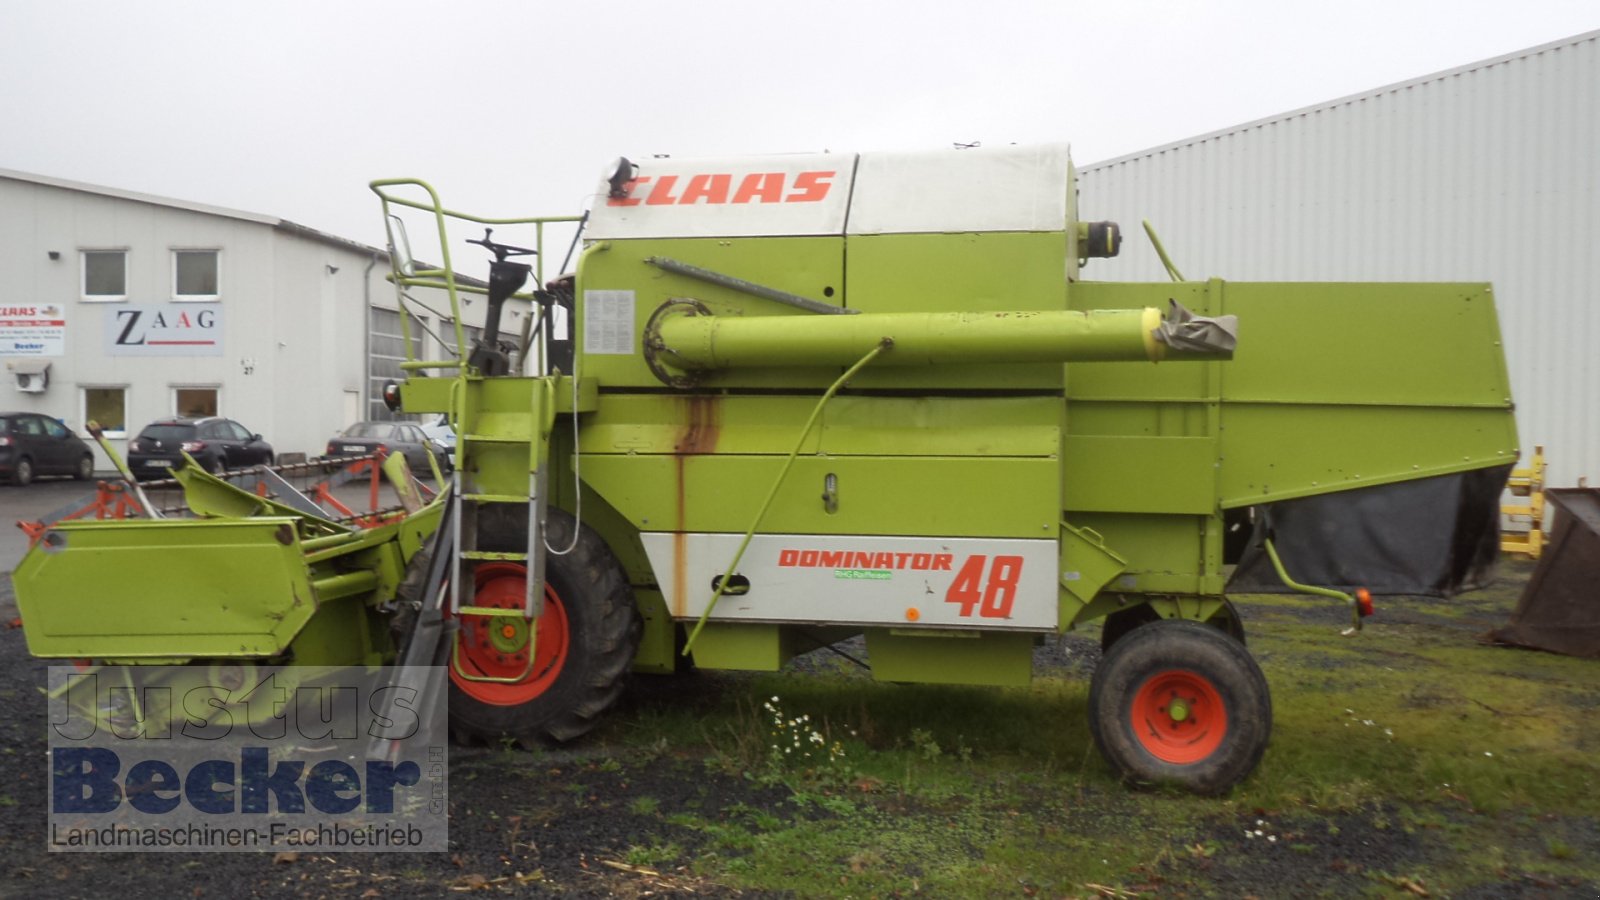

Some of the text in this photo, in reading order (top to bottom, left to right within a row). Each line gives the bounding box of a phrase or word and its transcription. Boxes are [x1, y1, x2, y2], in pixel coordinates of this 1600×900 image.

[115, 310, 215, 345] ZAAG
[778, 549, 1024, 618] DOMINATOR 48
